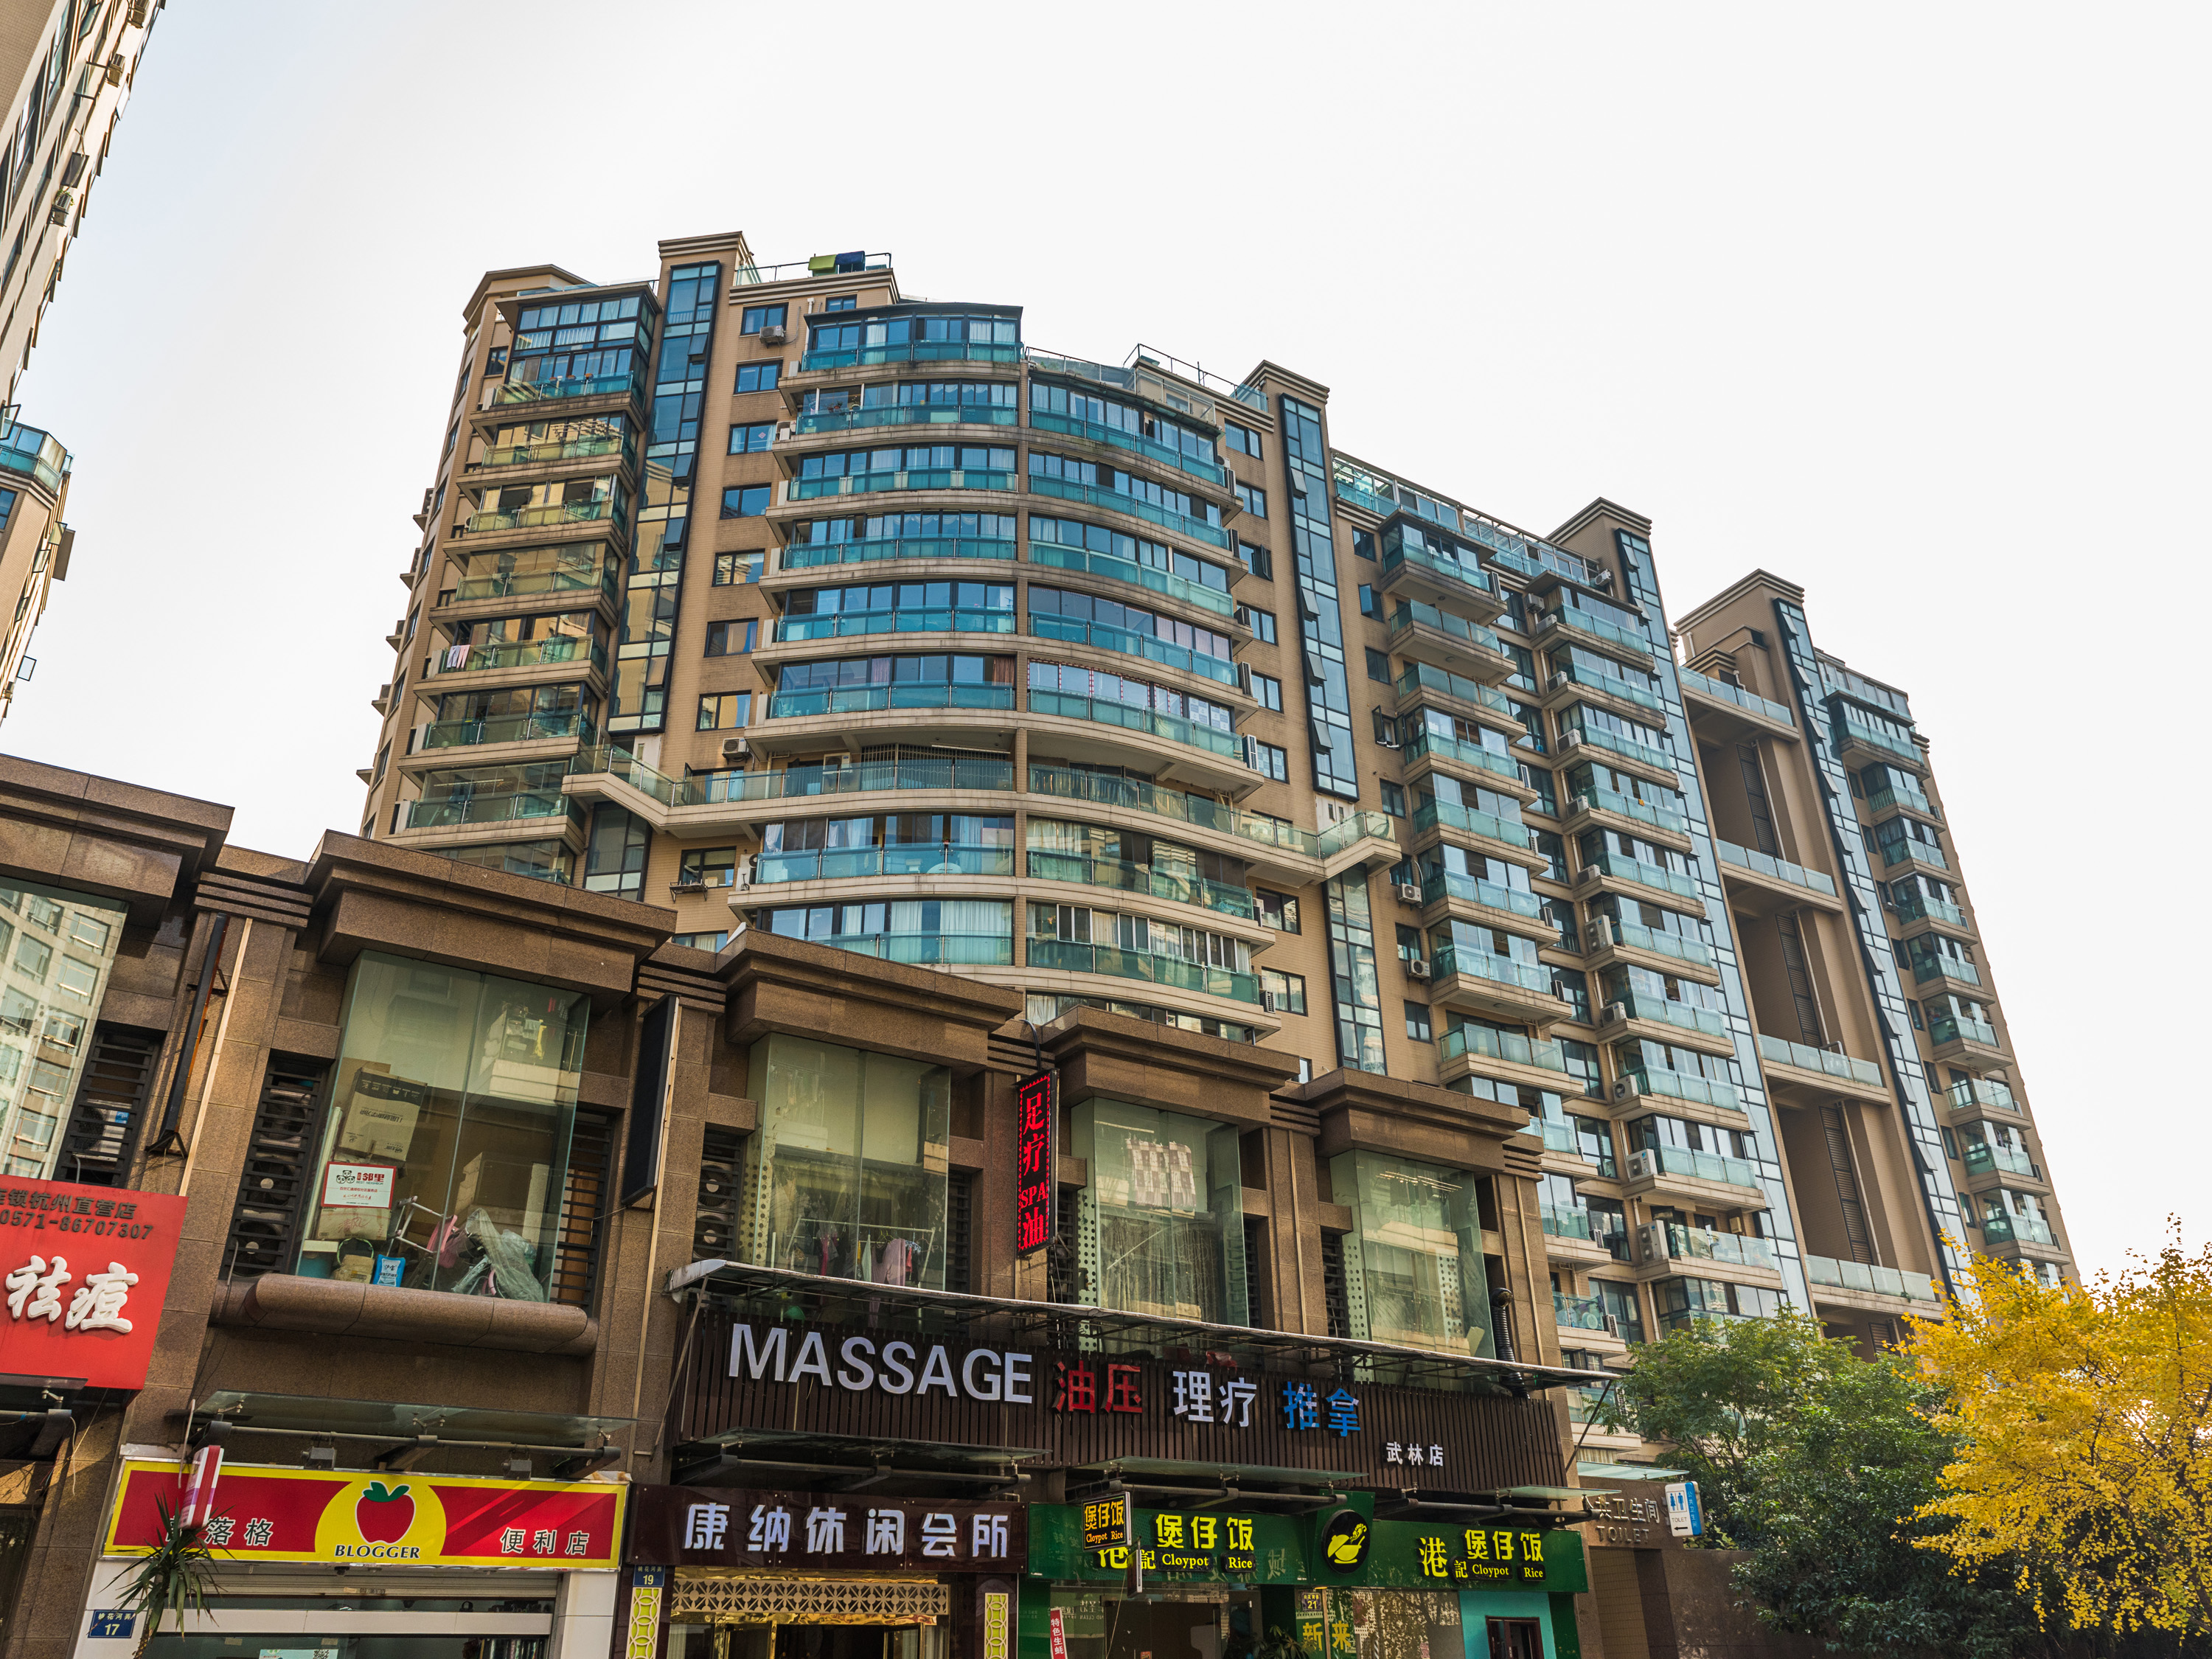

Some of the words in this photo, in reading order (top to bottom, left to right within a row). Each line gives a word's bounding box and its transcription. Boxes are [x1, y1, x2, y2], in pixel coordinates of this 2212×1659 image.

[0, 1209, 154, 1239] 0571-86707307
[6, 1255, 139, 1334] 祛痘
[728, 1324, 1032, 1403] MASSAGE
[1052, 1360, 1143, 1413] 油压
[1172, 1371, 1257, 1427] 理疗
[1283, 1381, 1361, 1437] 推拿
[1386, 1441, 1444, 1467] 武林店
[1085, 1500, 1124, 1531] 煲仔饭
[501, 1528, 590, 1556] 便利店
[684, 1502, 1009, 1559] 康纳休闲会所
[1086, 1532, 1107, 1544] Cloypot
[1110, 1531, 1124, 1540] Rice
[1155, 1514, 1254, 1551] 煲仔饭
[1596, 1526, 1649, 1543] TOILET
[335, 1544, 420, 1559] BLOGGER
[1465, 1529, 1544, 1562] 煲仔饭
[1162, 1554, 1208, 1569] Cloypot
[1228, 1557, 1253, 1568] Rice
[1472, 1564, 1509, 1578] Cloypot
[1523, 1567, 1543, 1578] Rice
[643, 1574, 654, 1585] 19
[1307, 1601, 1317, 1609] 21
[105, 1624, 120, 1635] 17
[1332, 1620, 1351, 1650] 来
